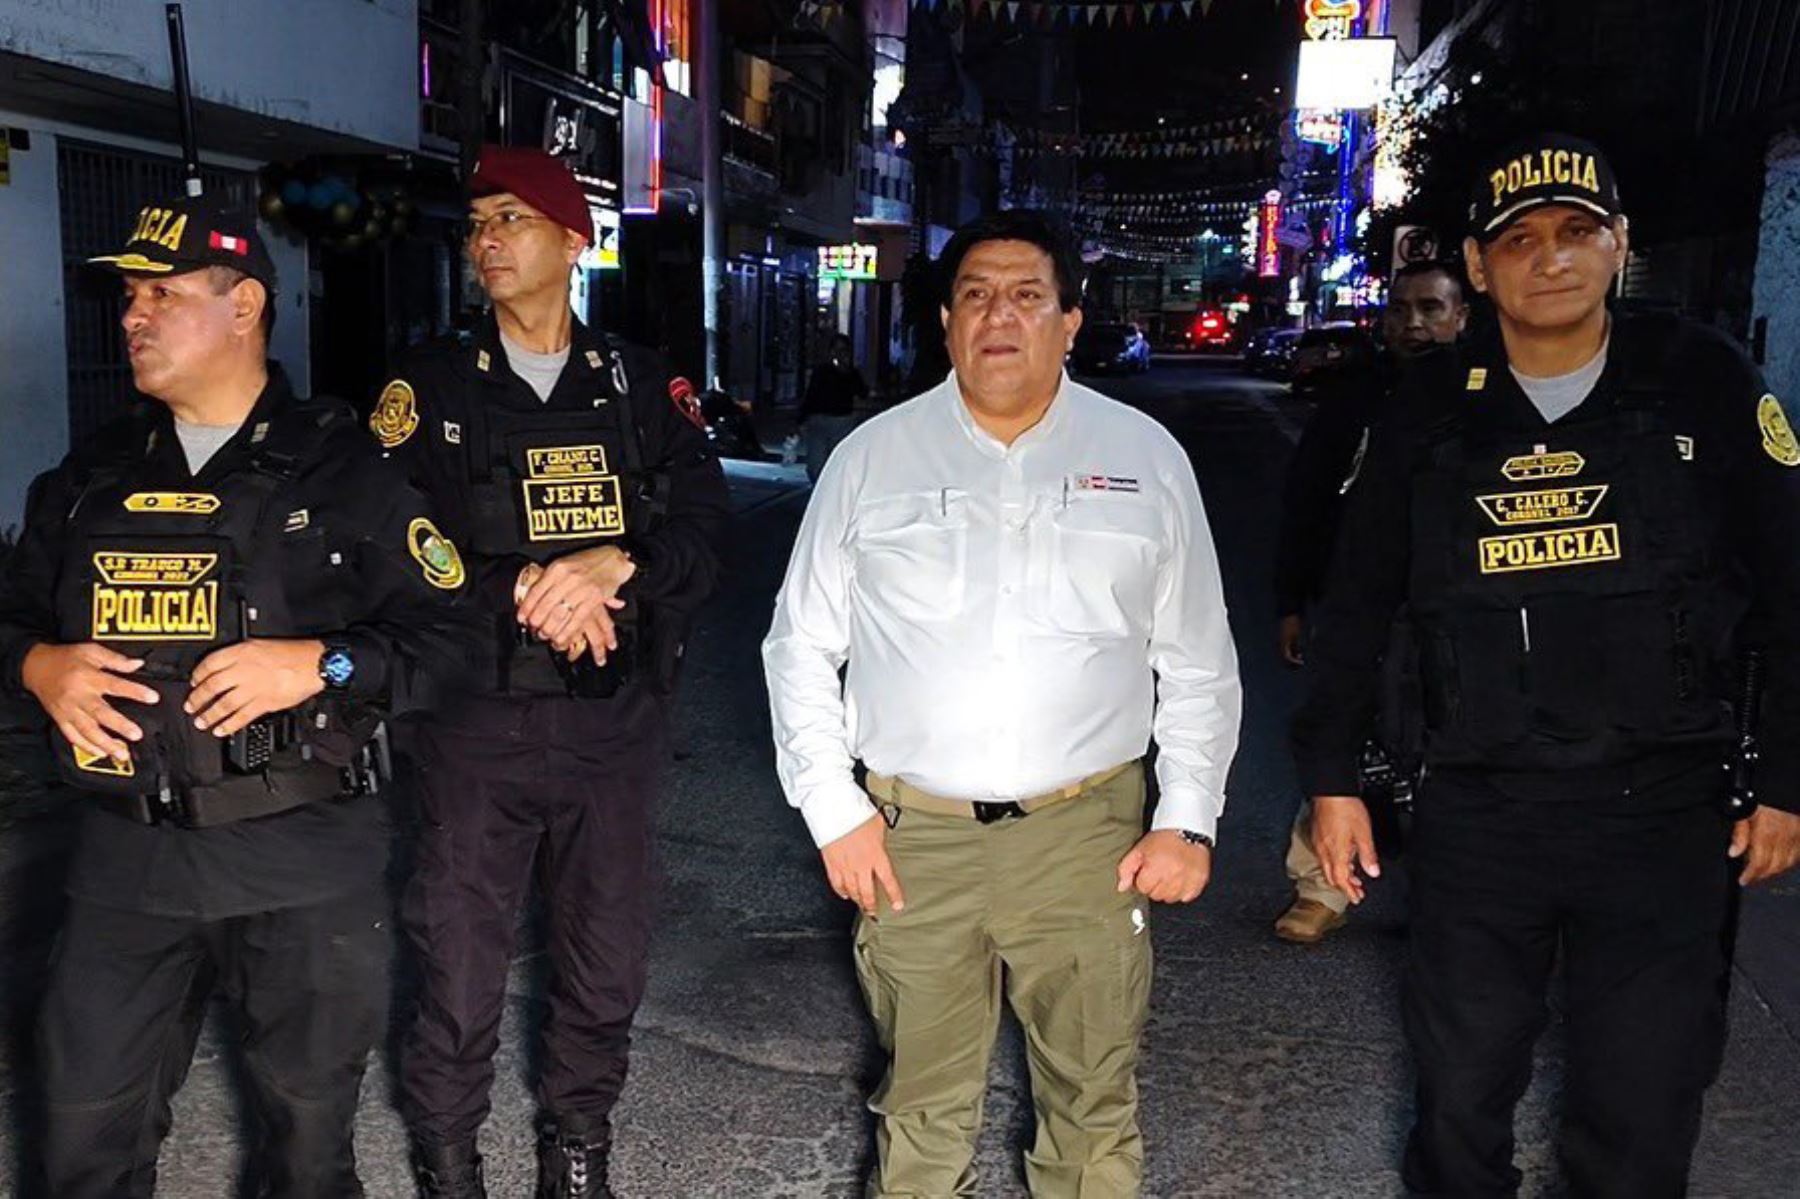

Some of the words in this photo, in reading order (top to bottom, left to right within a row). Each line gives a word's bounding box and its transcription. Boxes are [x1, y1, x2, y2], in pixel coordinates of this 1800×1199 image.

[1489, 149, 1600, 207] POLICIA
[543, 484, 604, 504] JEFE
[1515, 493, 1569, 511] CALERO
[532, 505, 619, 532] DIVEME
[1485, 528, 1614, 567] POLICIA
[97, 587, 212, 633] POLICIA
